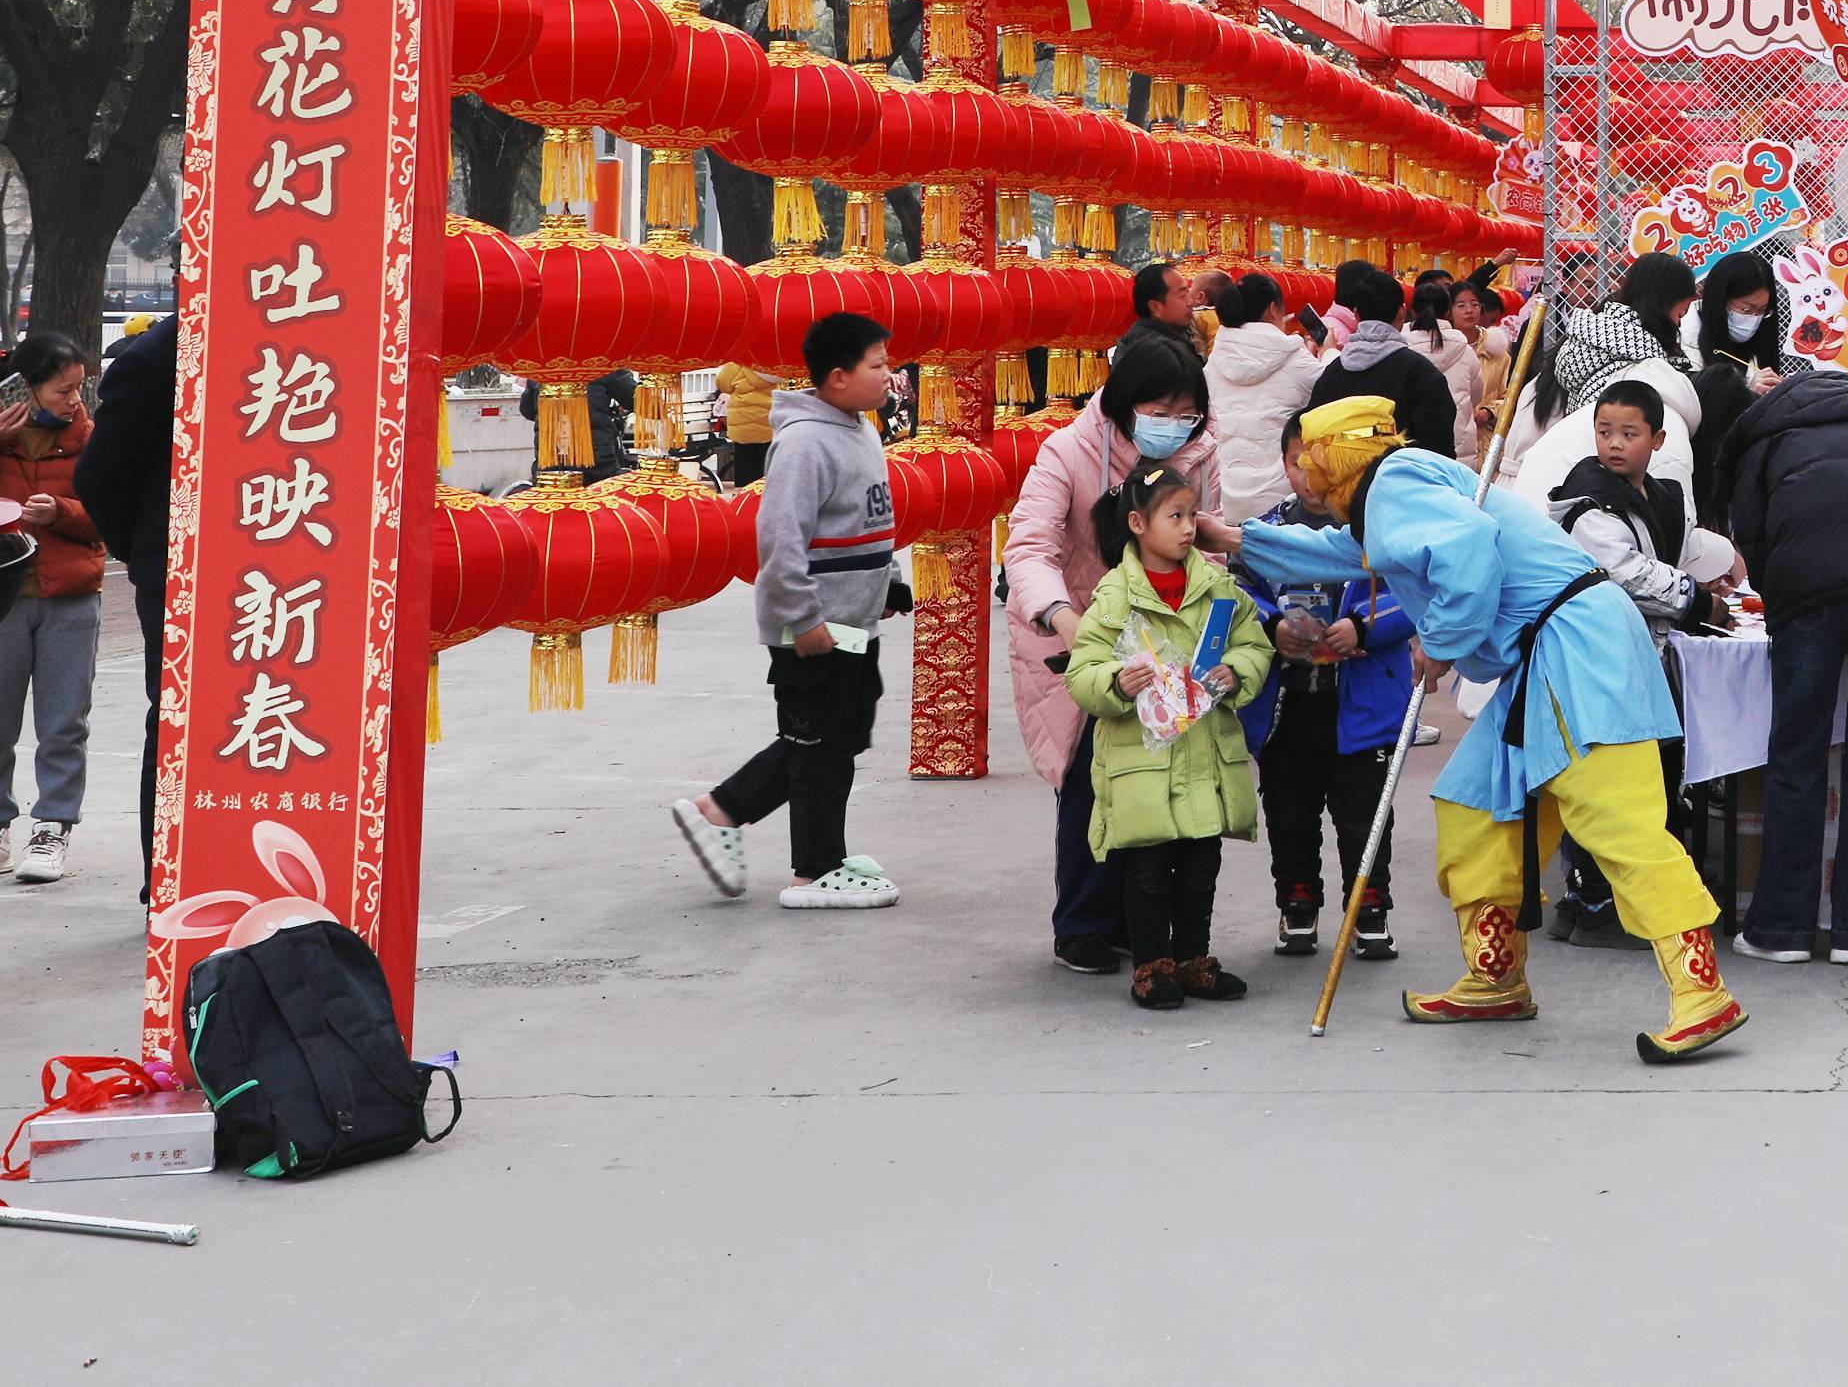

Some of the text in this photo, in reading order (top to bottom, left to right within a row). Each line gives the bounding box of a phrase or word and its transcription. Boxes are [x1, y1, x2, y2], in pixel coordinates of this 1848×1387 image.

[194, 790, 350, 812] 林州农商银行
